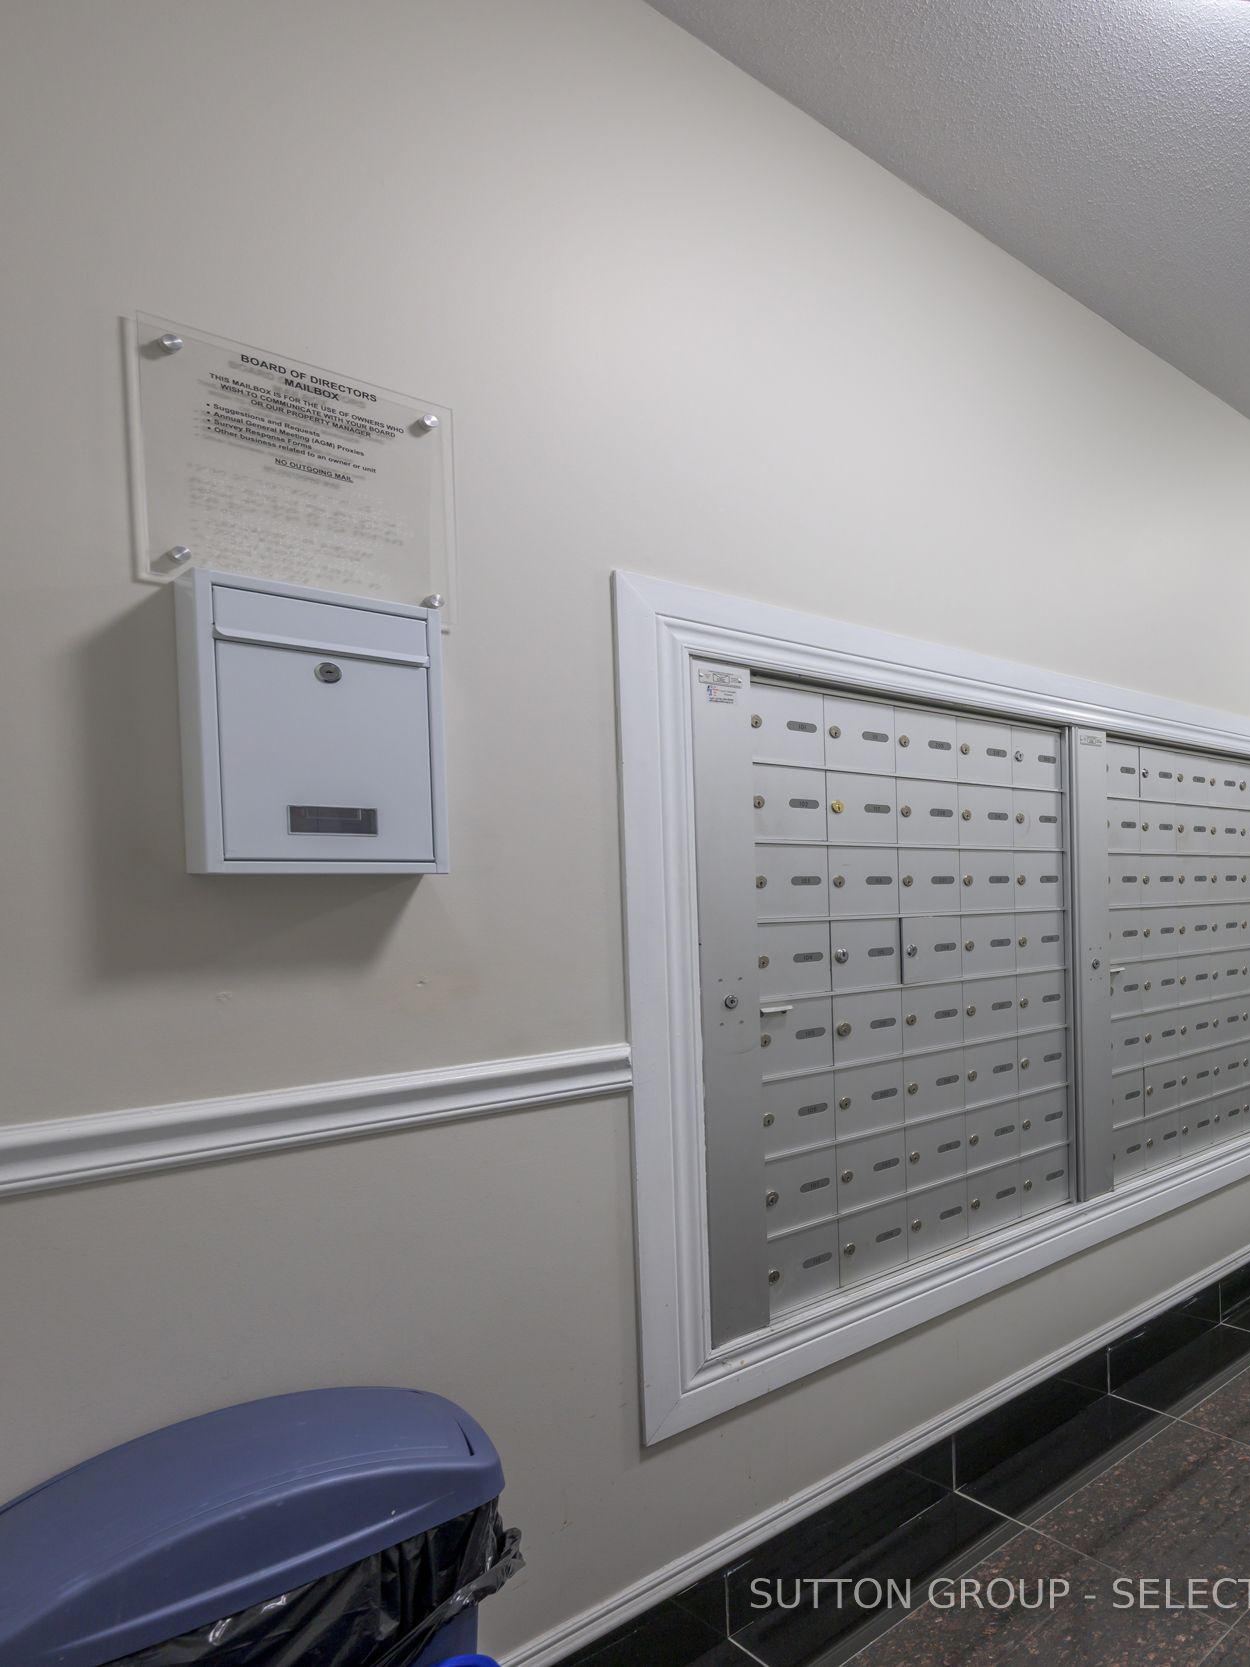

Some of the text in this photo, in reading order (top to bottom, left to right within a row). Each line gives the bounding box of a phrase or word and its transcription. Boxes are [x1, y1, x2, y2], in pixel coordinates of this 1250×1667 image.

[240, 354, 377, 402] BOARD OF DIRECTORS
[284, 378, 340, 401] MAILBOX
[209, 372, 230, 383] THIS
[232, 379, 271, 395] MAILBOX
[283, 394, 301, 404] FOR
[302, 399, 319, 409] THE
[321, 405, 337, 415] USE
[351, 414, 385, 429] OWNERS
[386, 424, 405, 434] WHO
[213, 403, 320, 437] Suggestions and Requests
[220, 383, 396, 438] WISH TO COMMUNICATE WITH YOUR BOARD
[250, 399, 371, 438] OR OUR PROPERTY MANAGER
[213, 411, 365, 456] Annual General Meeting (AGM) Proxies
[214, 419, 312, 450] Survey Response Forms
[214, 426, 238, 438] Other
[240, 433, 277, 448] business
[278, 444, 306, 455] related
[328, 457, 351, 466] owner
[362, 466, 377, 474] unit
[275, 457, 352, 482] NO OUTGOING MAIL
